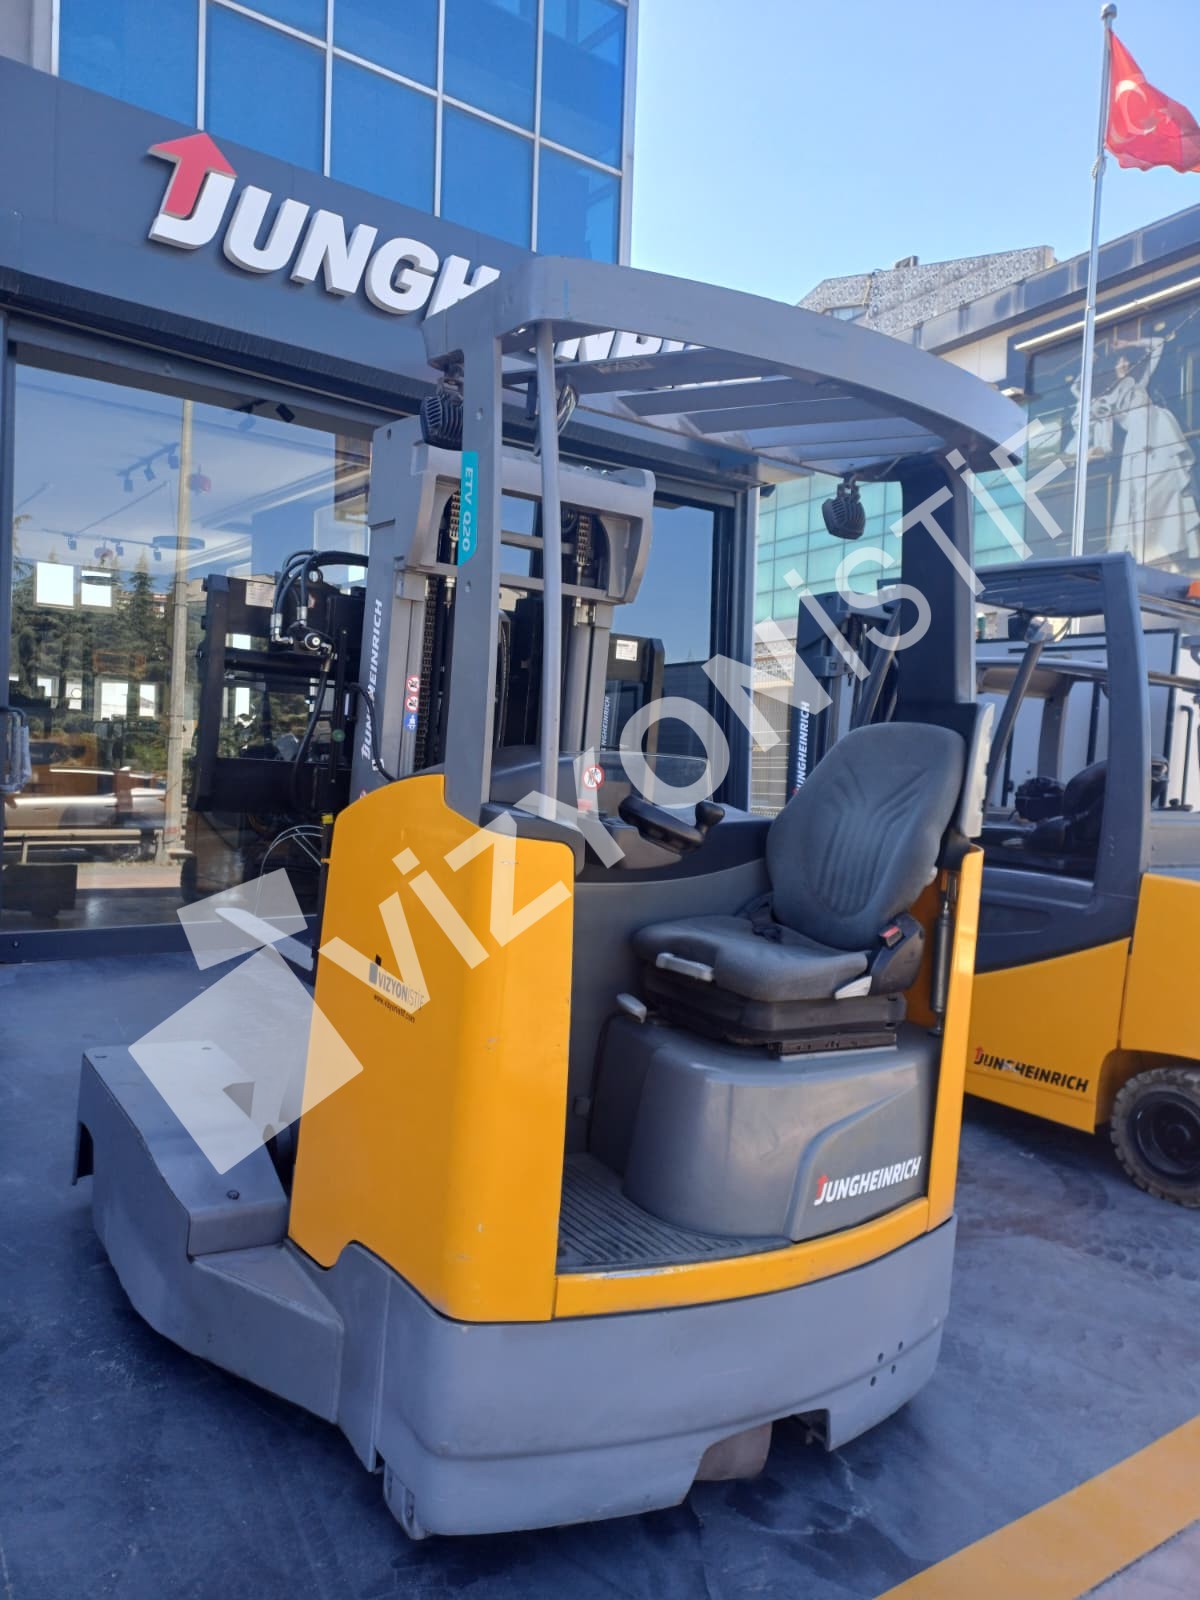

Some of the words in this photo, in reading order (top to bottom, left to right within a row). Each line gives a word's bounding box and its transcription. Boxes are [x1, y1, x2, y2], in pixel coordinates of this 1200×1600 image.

[464, 467, 473, 504] ETV
[361, 599, 383, 760] JUNHEINRICH
[795, 701, 810, 791] UNGHEINRICH
[814, 1156, 922, 1206] JUNGHEINRICH
